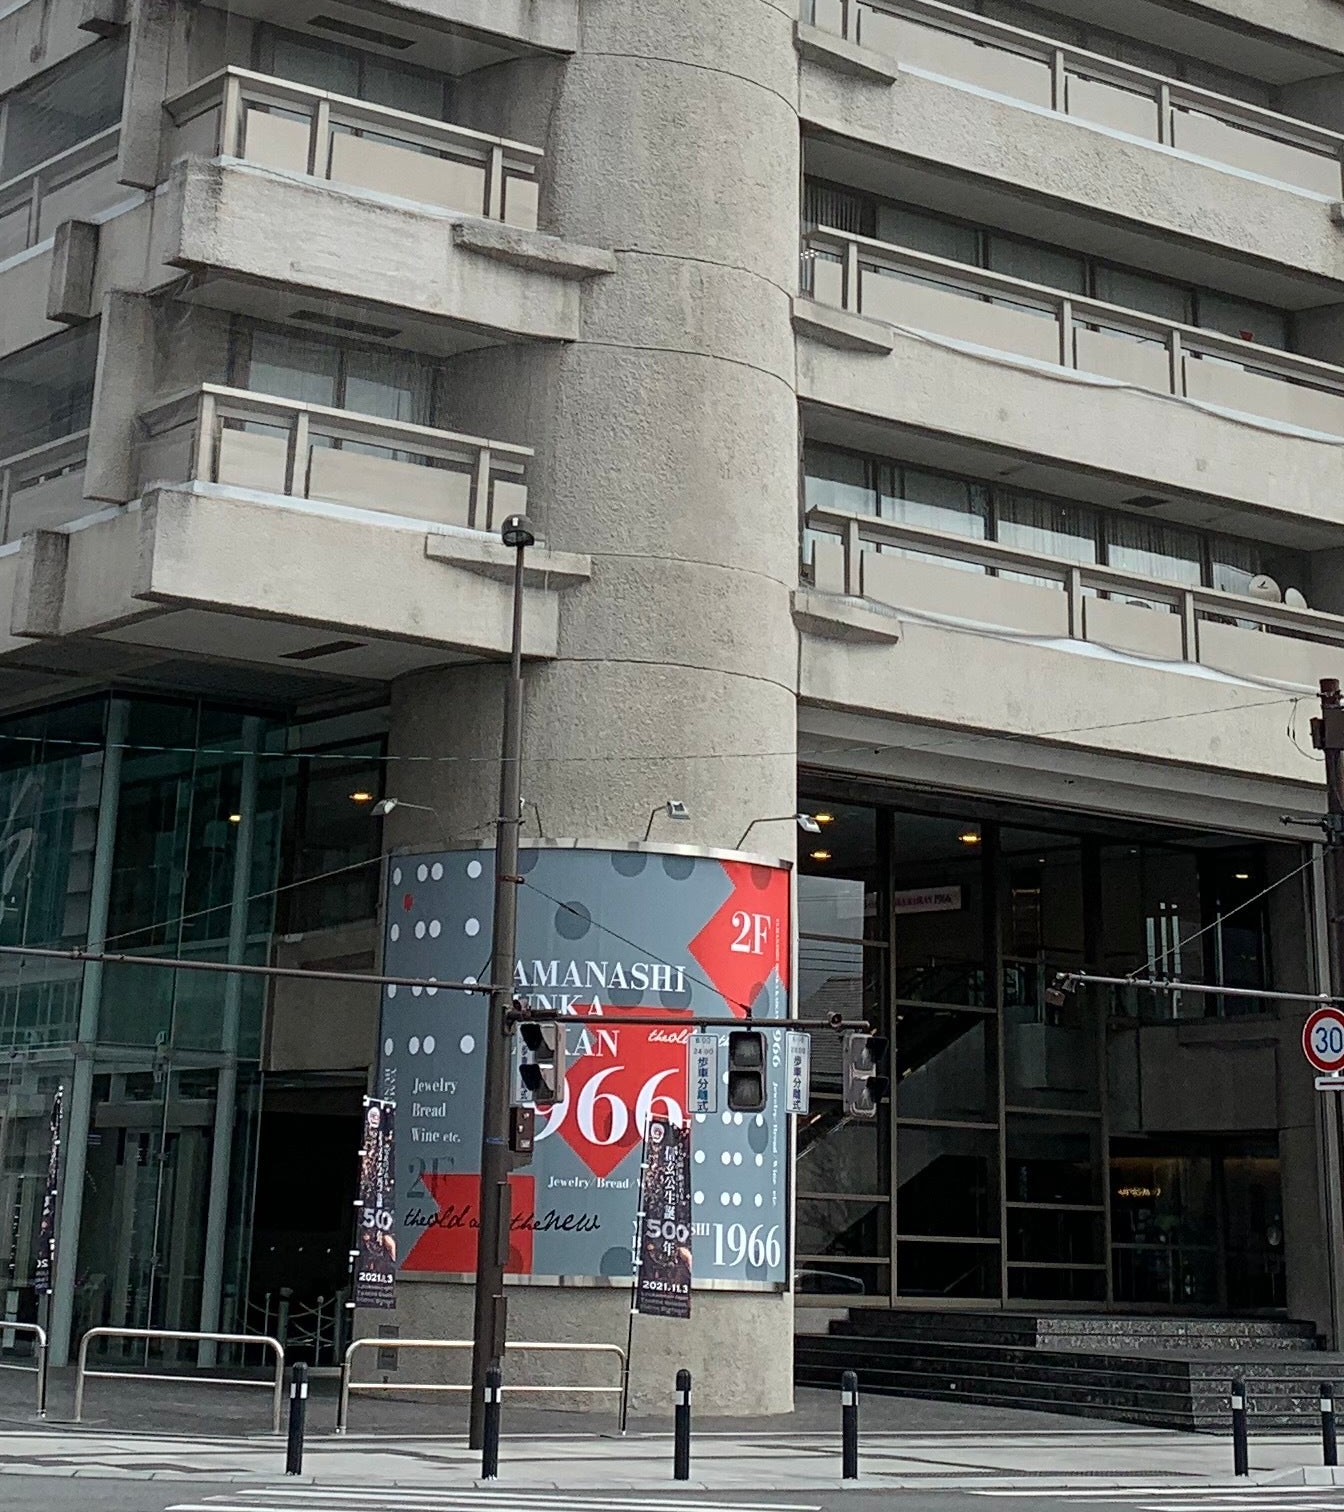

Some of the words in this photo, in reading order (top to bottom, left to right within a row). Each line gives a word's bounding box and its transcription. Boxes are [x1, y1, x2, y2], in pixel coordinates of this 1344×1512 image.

[730, 910, 771, 955] 2F
[513, 960, 686, 993] AMANASHI
[1316, 1027, 1343, 1053] 30
[412, 1077, 458, 1094] Jewelry
[412, 1103, 446, 1118] Bread
[522, 1065, 684, 1146] 966
[411, 1128, 440, 1142] Wine
[443, 1132, 461, 1143] etc.
[712, 1223, 781, 1268] 1966
